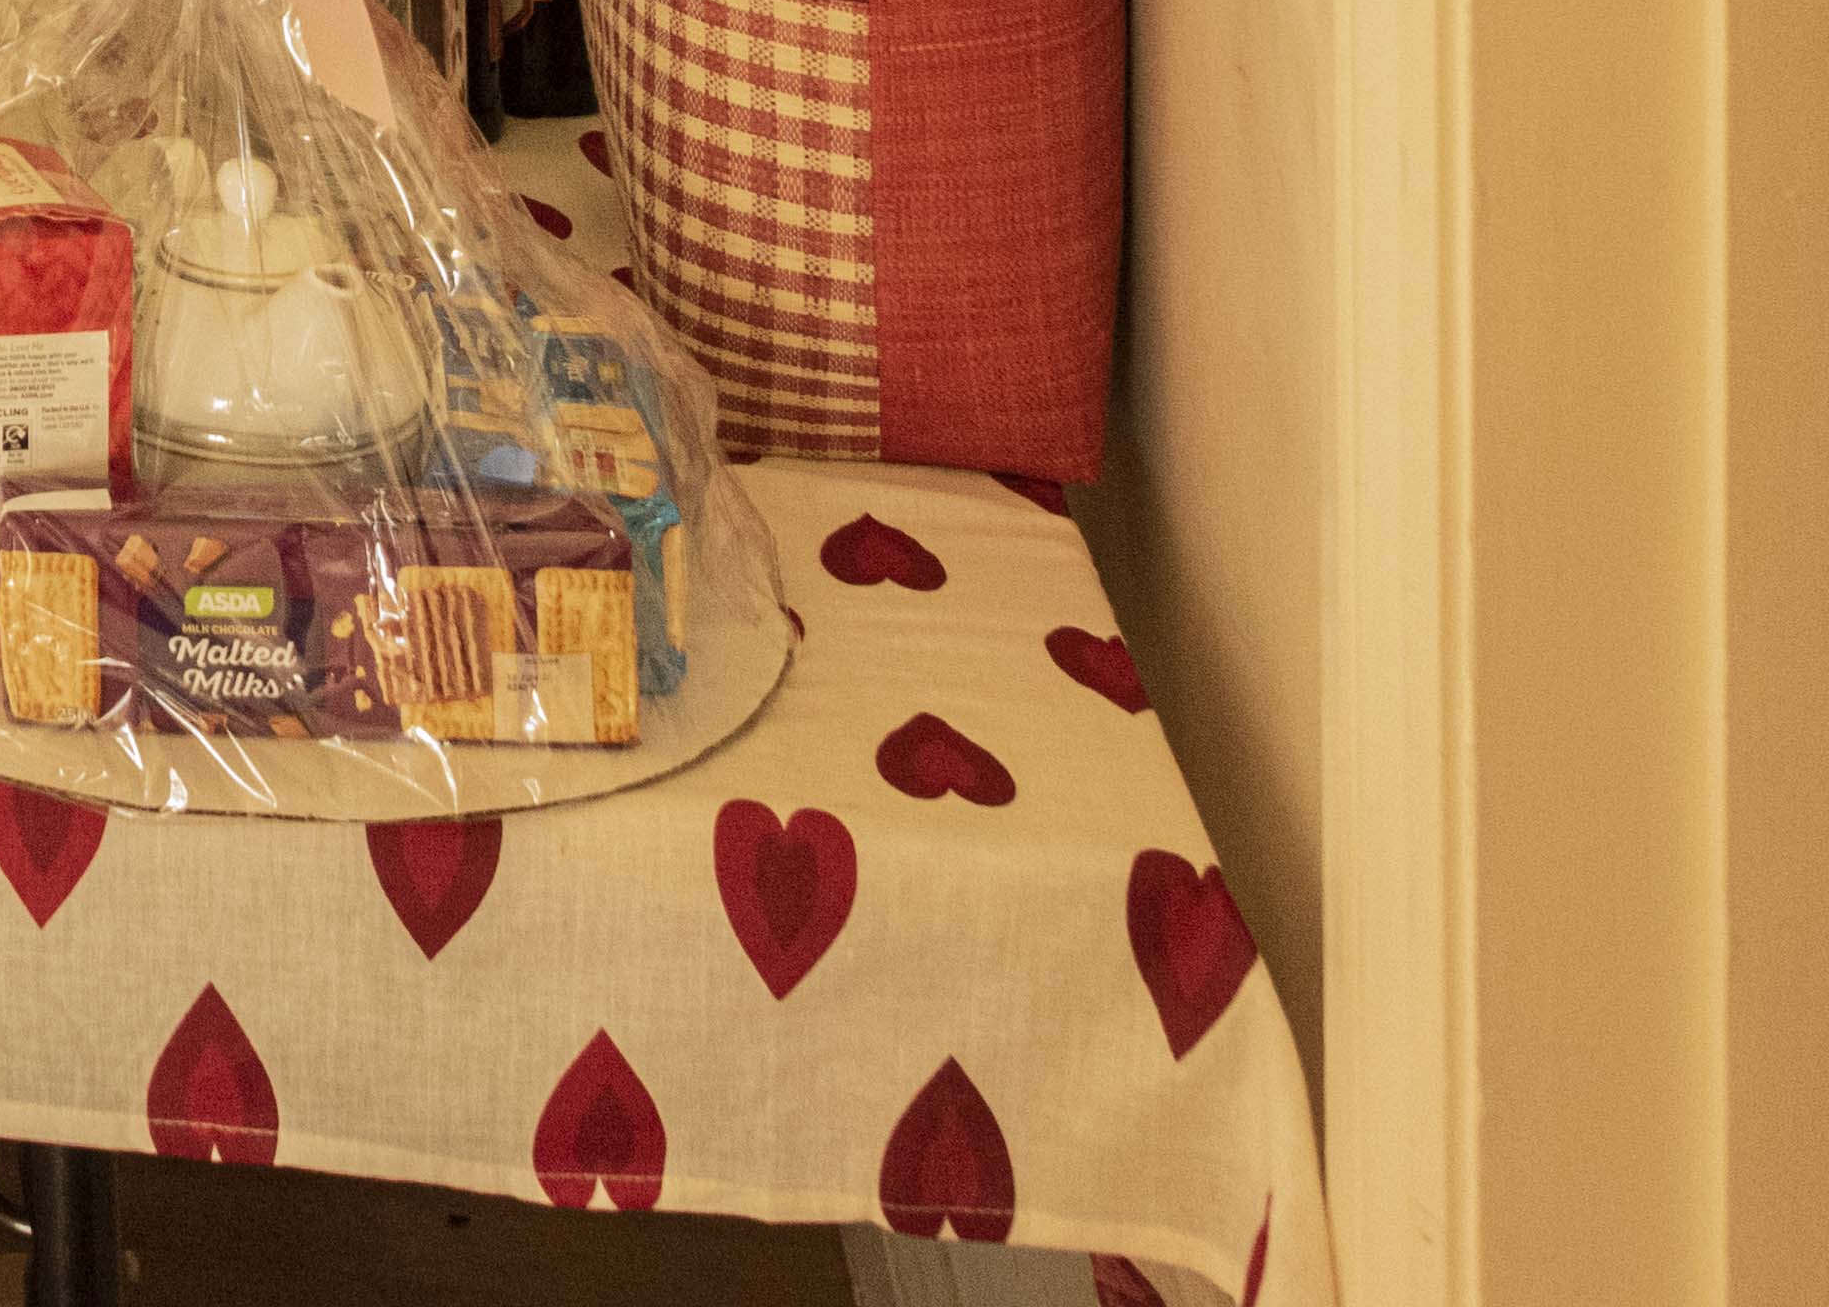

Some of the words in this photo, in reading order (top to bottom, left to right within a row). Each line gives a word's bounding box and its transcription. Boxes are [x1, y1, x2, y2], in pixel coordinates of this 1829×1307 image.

[197, 591, 262, 614] ASDA
[181, 623, 209, 635] MILK
[211, 624, 278, 636] CHOCOLATE
[168, 635, 297, 668] Malted
[182, 668, 284, 701] Milks
